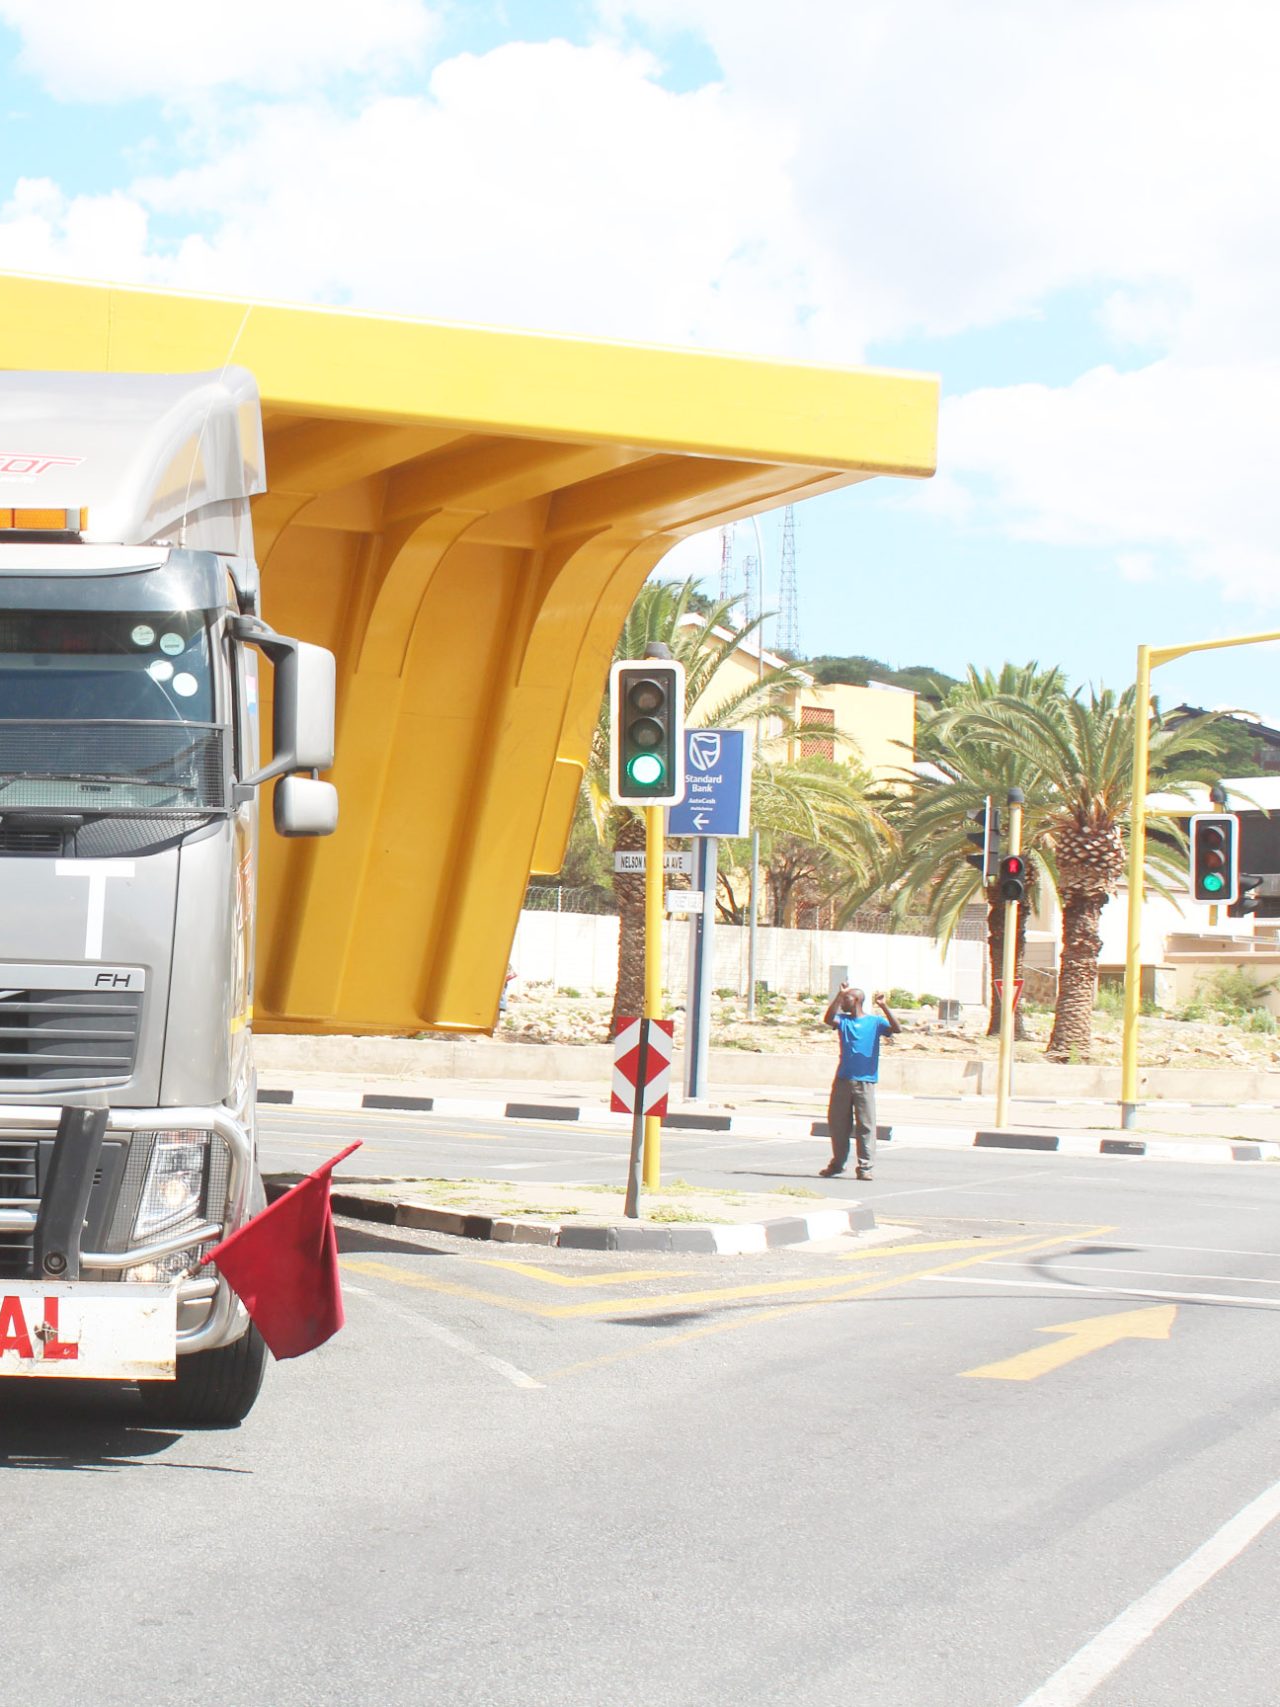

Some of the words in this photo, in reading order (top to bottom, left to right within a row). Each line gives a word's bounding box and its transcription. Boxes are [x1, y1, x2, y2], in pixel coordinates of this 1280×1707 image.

[685, 774, 723, 785] Standard
[691, 783, 714, 793] Bank
[621, 856, 643, 869] NELSON
[55, 859, 136, 960] T
[94, 973, 132, 988] FH
